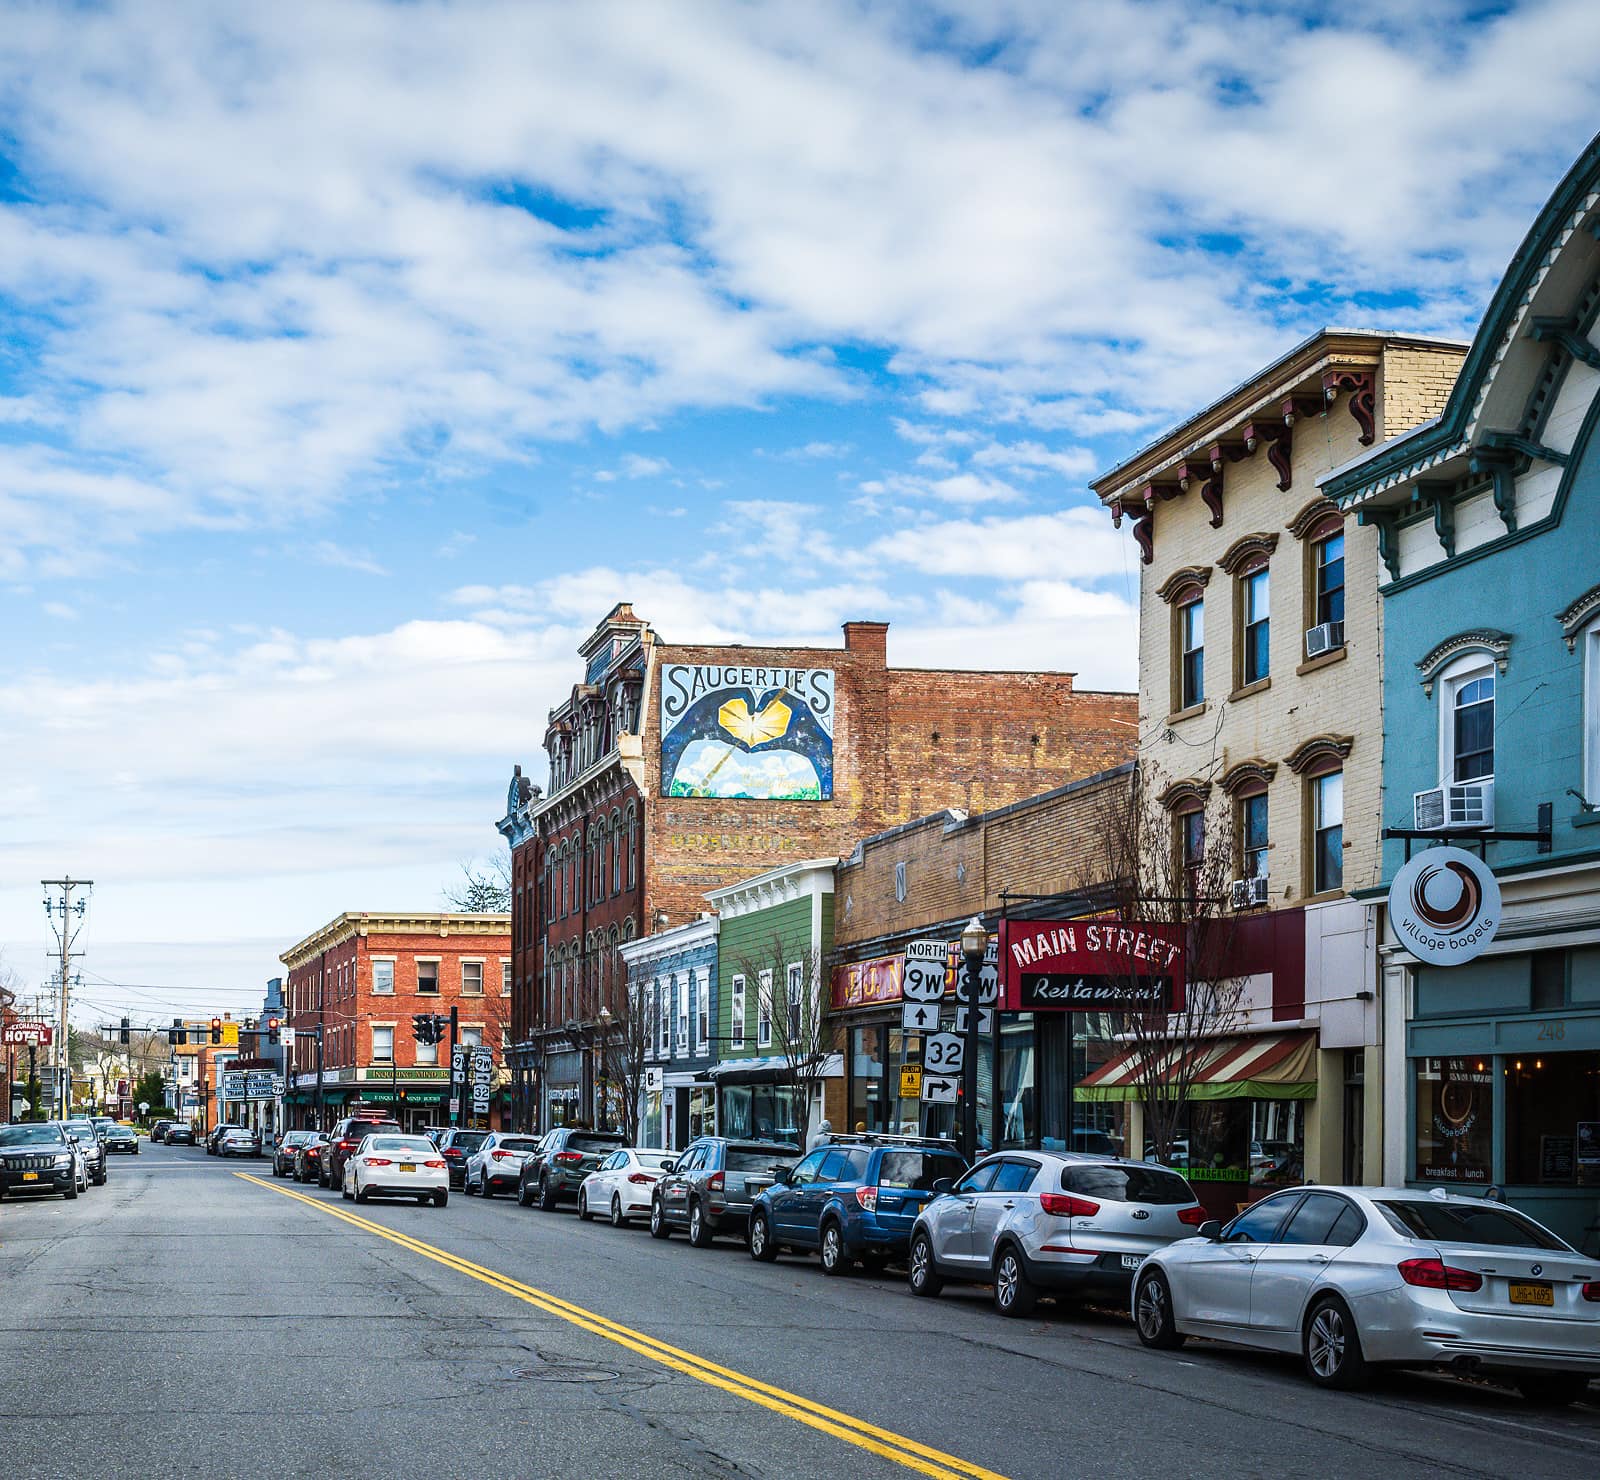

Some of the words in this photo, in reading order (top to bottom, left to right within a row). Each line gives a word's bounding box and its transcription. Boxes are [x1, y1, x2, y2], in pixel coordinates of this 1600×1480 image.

[665, 665, 831, 716] SAUGERTIES
[1402, 918, 1445, 951] village
[1449, 918, 1493, 949] bagels
[909, 944, 945, 957] NORTH
[1011, 927, 1077, 968] MAIN
[1086, 925, 1181, 968] STREET
[908, 969, 942, 993] 9W
[1033, 977, 1162, 1000] Restaurant
[5, 1030, 47, 1041] HOTEL
[1537, 1021, 1566, 1041] 248
[930, 1042, 960, 1065] 32
[476, 1058, 490, 1068] 9W
[373, 1070, 412, 1078] INQUIING
[274, 1084, 284, 1093] 9W
[475, 1088, 489, 1098] 32
[1194, 1168, 1246, 1180] MARGARITAS
[1425, 1167, 1457, 1177] breakfast
[1465, 1167, 1484, 1178] lunch
